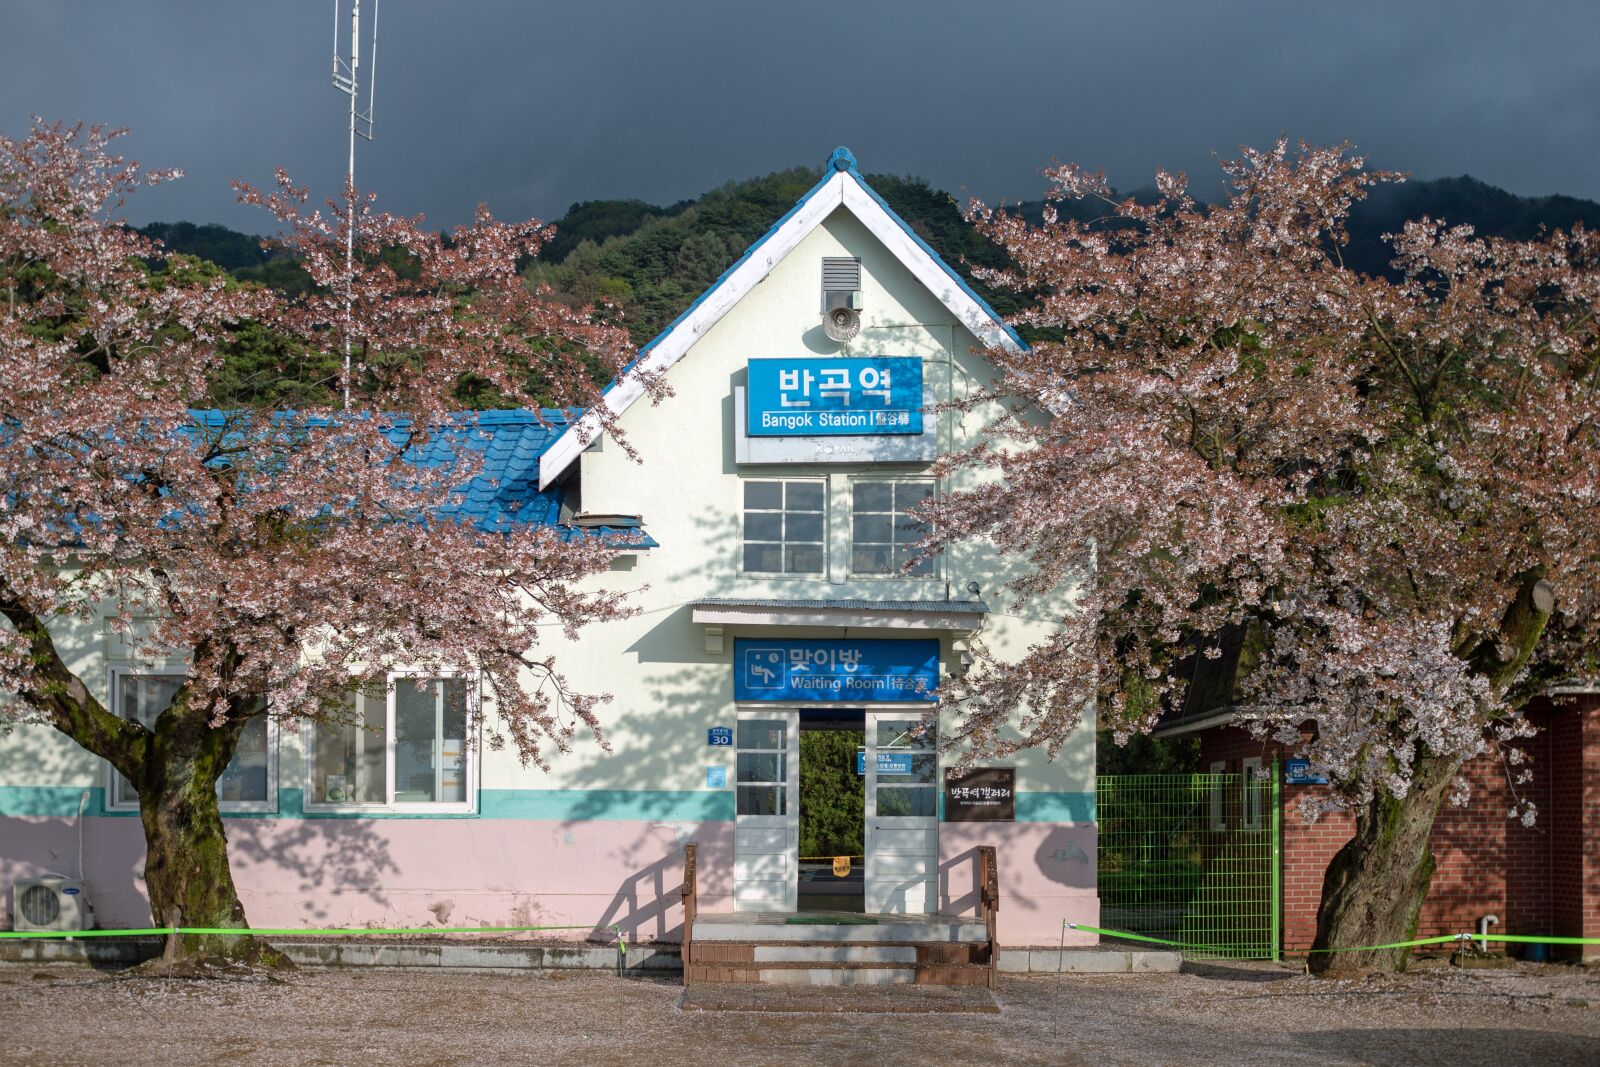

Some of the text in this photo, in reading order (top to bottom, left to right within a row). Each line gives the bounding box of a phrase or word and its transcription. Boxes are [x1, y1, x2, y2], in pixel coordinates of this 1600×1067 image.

[779, 367, 892, 407] 반곡역
[762, 413, 813, 430] Bangok
[819, 413, 866, 427] Station
[789, 648, 863, 673] 맞이방
[790, 676, 842, 692] Waiting
[846, 677, 885, 690] Room
[712, 735, 729, 745] 30
